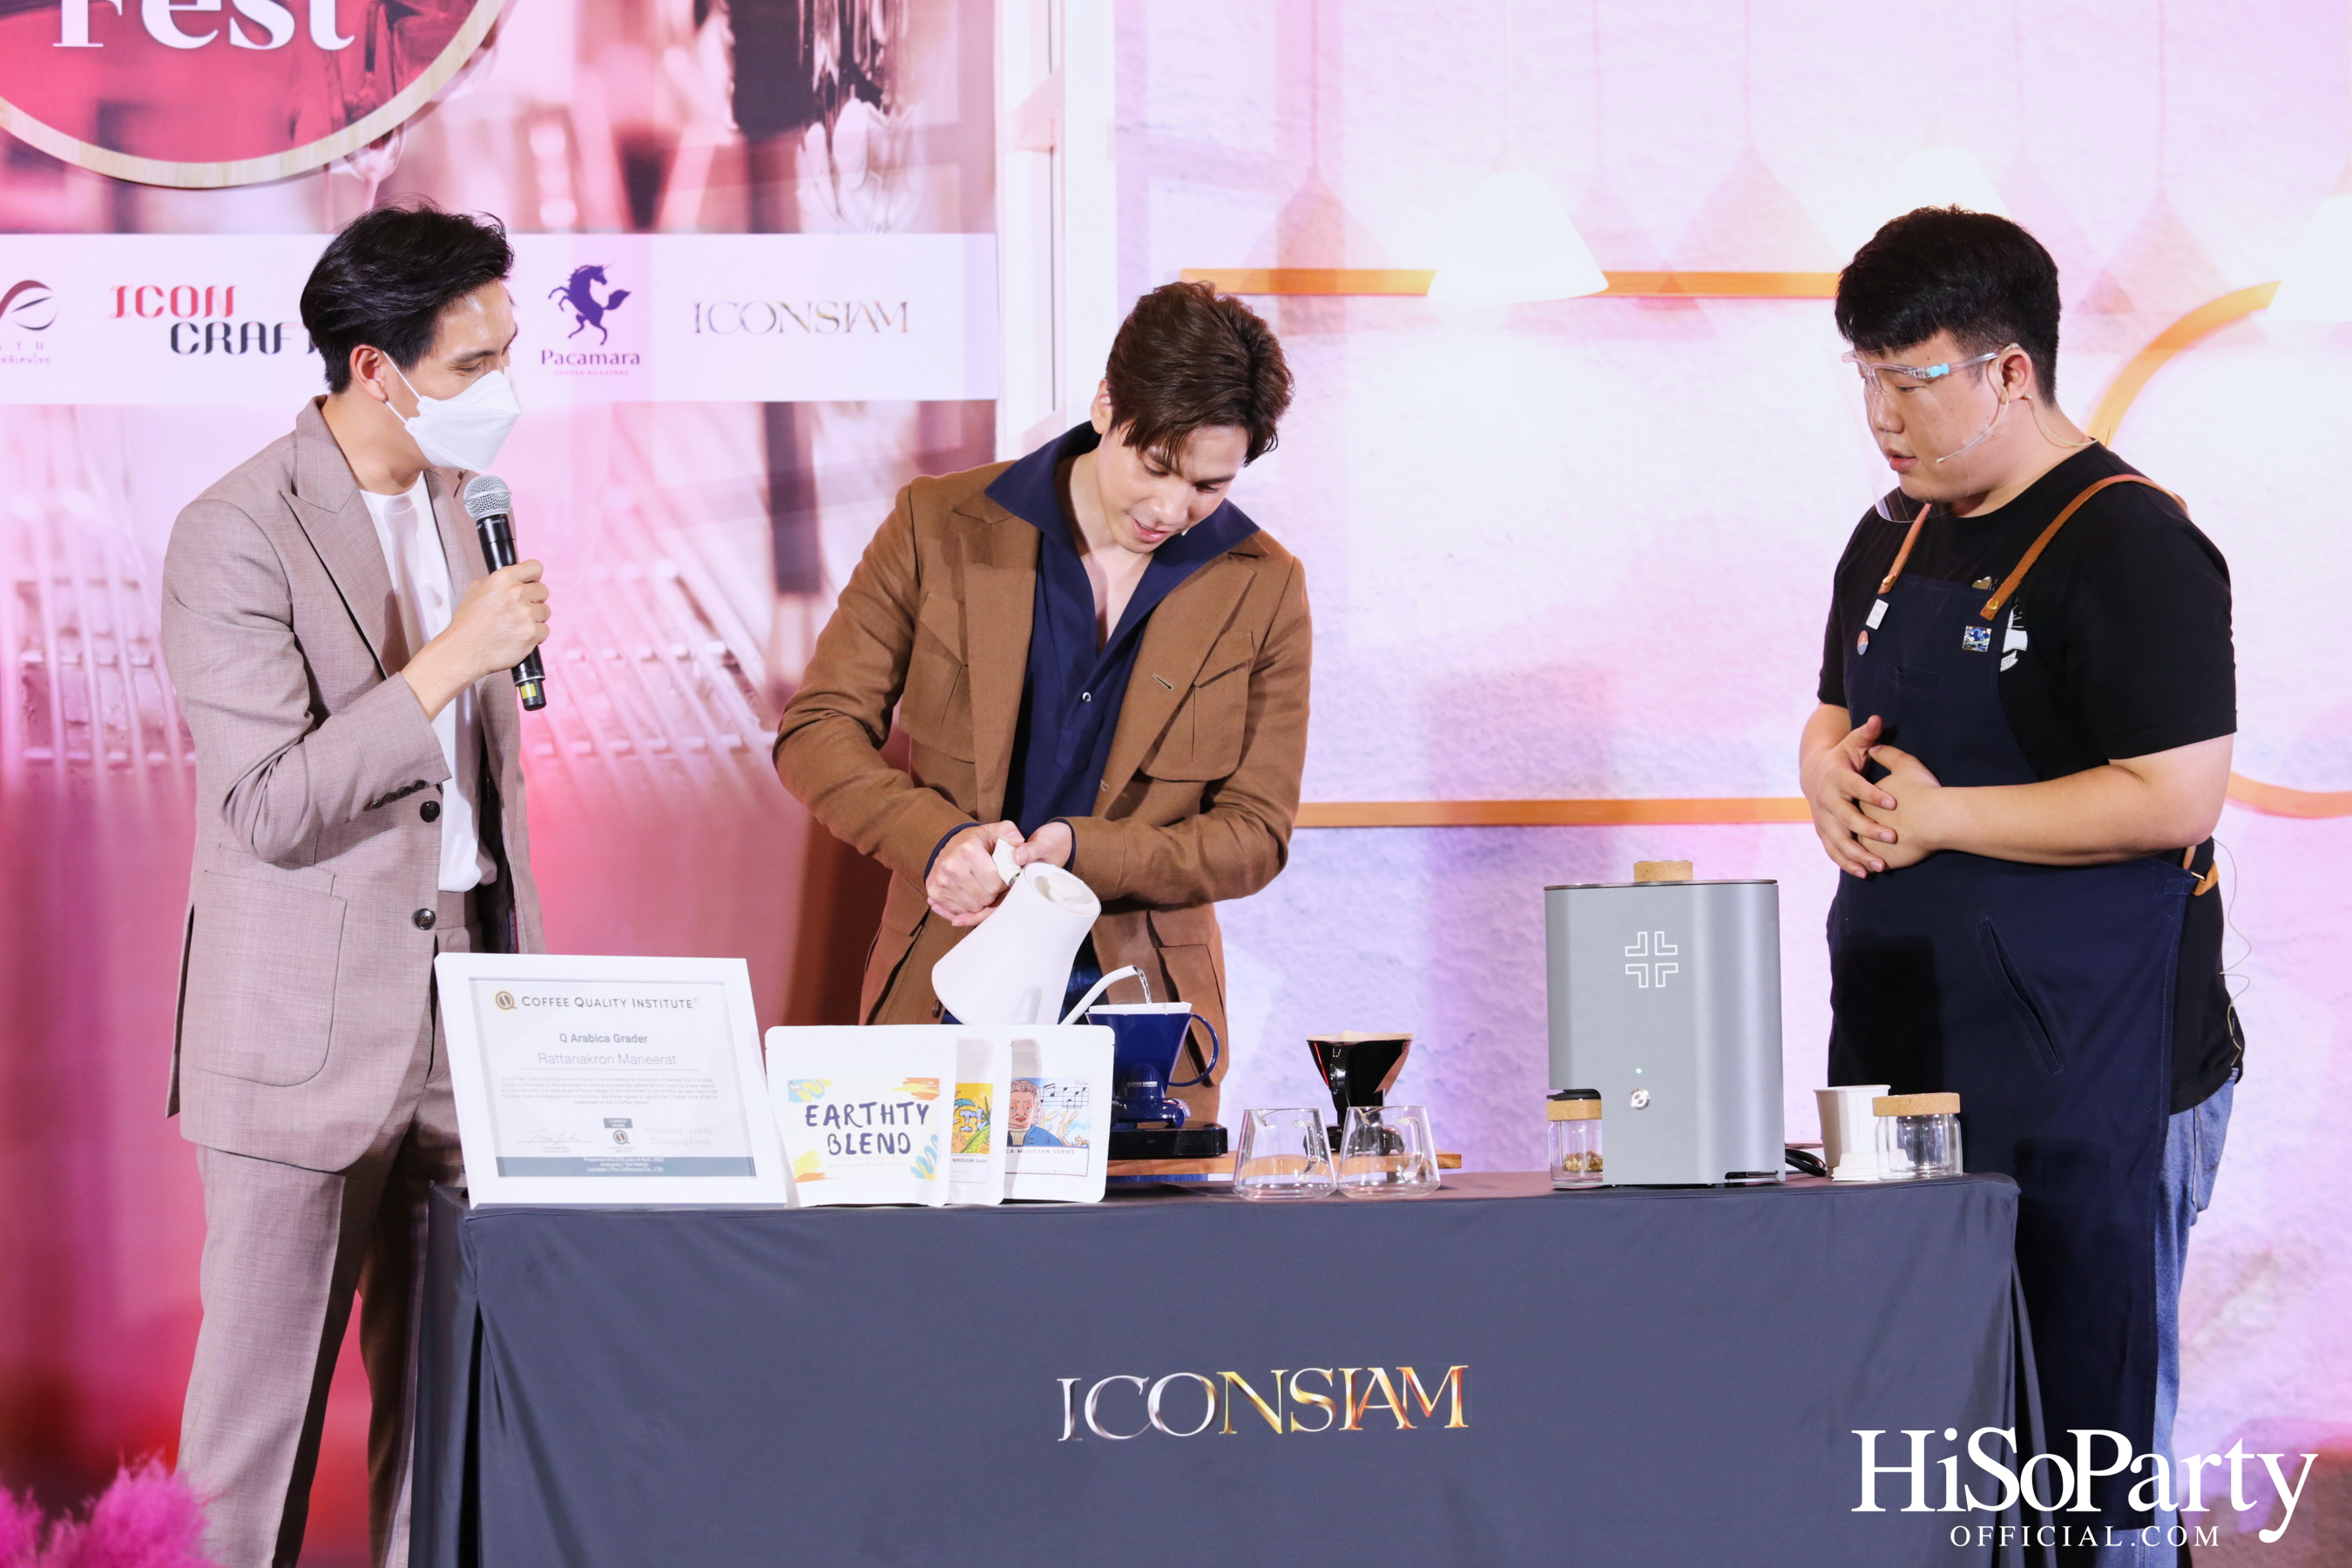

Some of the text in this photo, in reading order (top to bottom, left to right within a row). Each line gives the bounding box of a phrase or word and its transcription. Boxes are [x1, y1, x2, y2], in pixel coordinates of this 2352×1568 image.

[109, 285, 237, 319] ICON
[693, 301, 909, 335] ICONSIAM
[541, 349, 640, 365] Pacamara
[521, 996, 693, 1009] COFFEE QUALITY INSTITUTE
[559, 1033, 648, 1044] Q Arabica Grader
[537, 1052, 677, 1065] Rattanakron Maneerat
[805, 1101, 929, 1130] EARTHTY
[685, 1125, 713, 1136] Quality
[690, 1136, 712, 1146] Lives
[828, 1132, 911, 1156] BLEND
[1057, 1364, 1469, 1442] ICONSIAM
